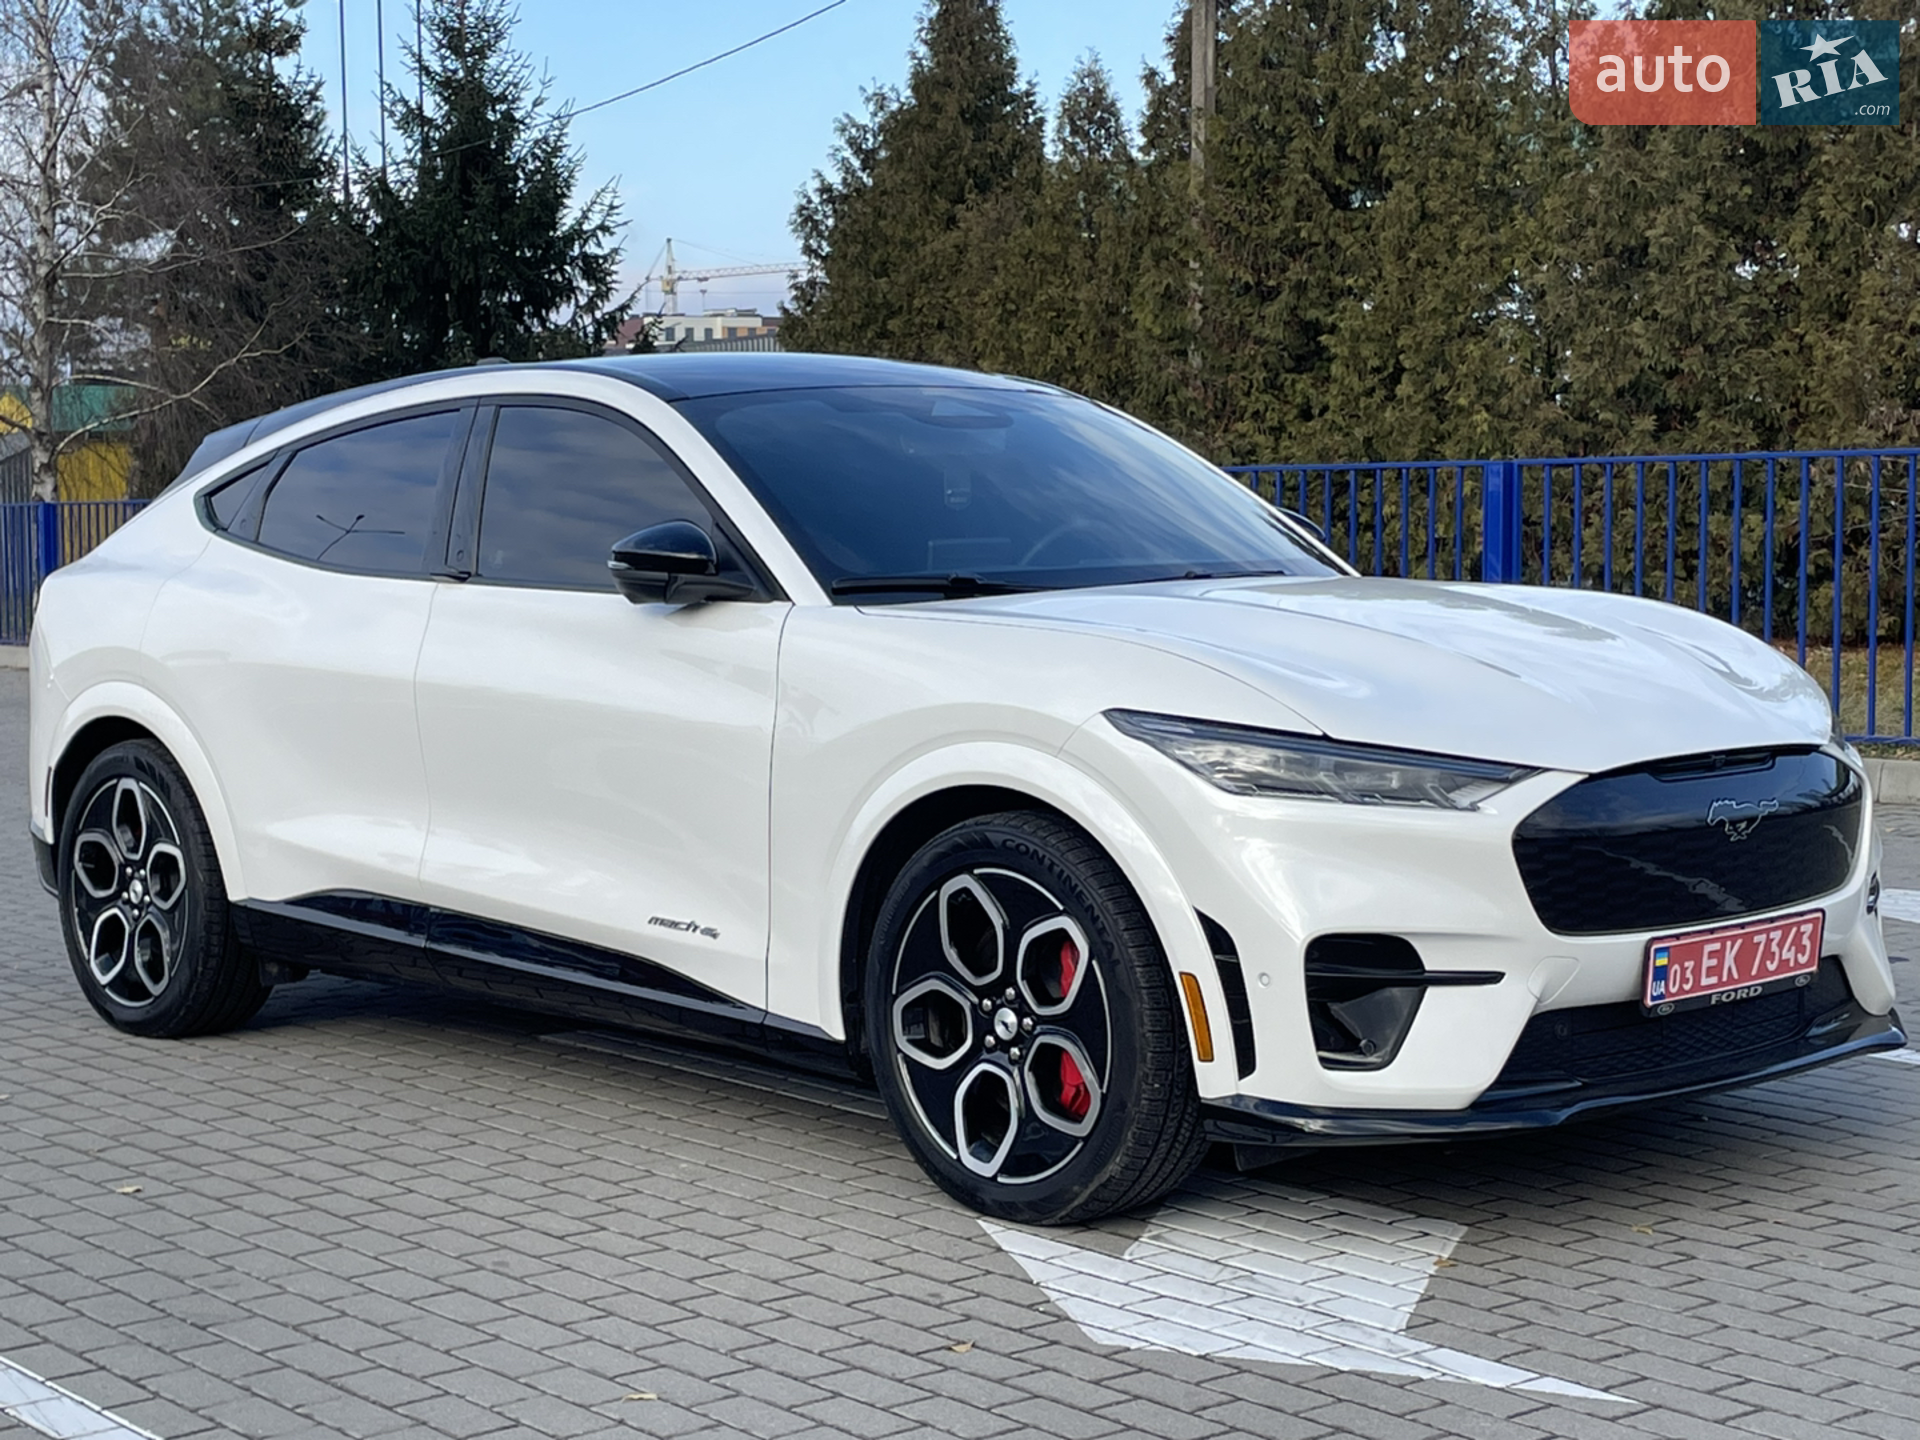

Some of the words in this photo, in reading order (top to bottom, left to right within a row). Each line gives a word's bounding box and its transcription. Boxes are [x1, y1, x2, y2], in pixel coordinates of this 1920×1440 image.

[1002, 838, 1121, 968] CONTINENTAL
[1668, 960, 1695, 993] 03
[1701, 938, 1743, 986] EK
[1751, 923, 1813, 976] 7343
[1652, 980, 1666, 996] UA
[1710, 986, 1763, 1005] FORD
